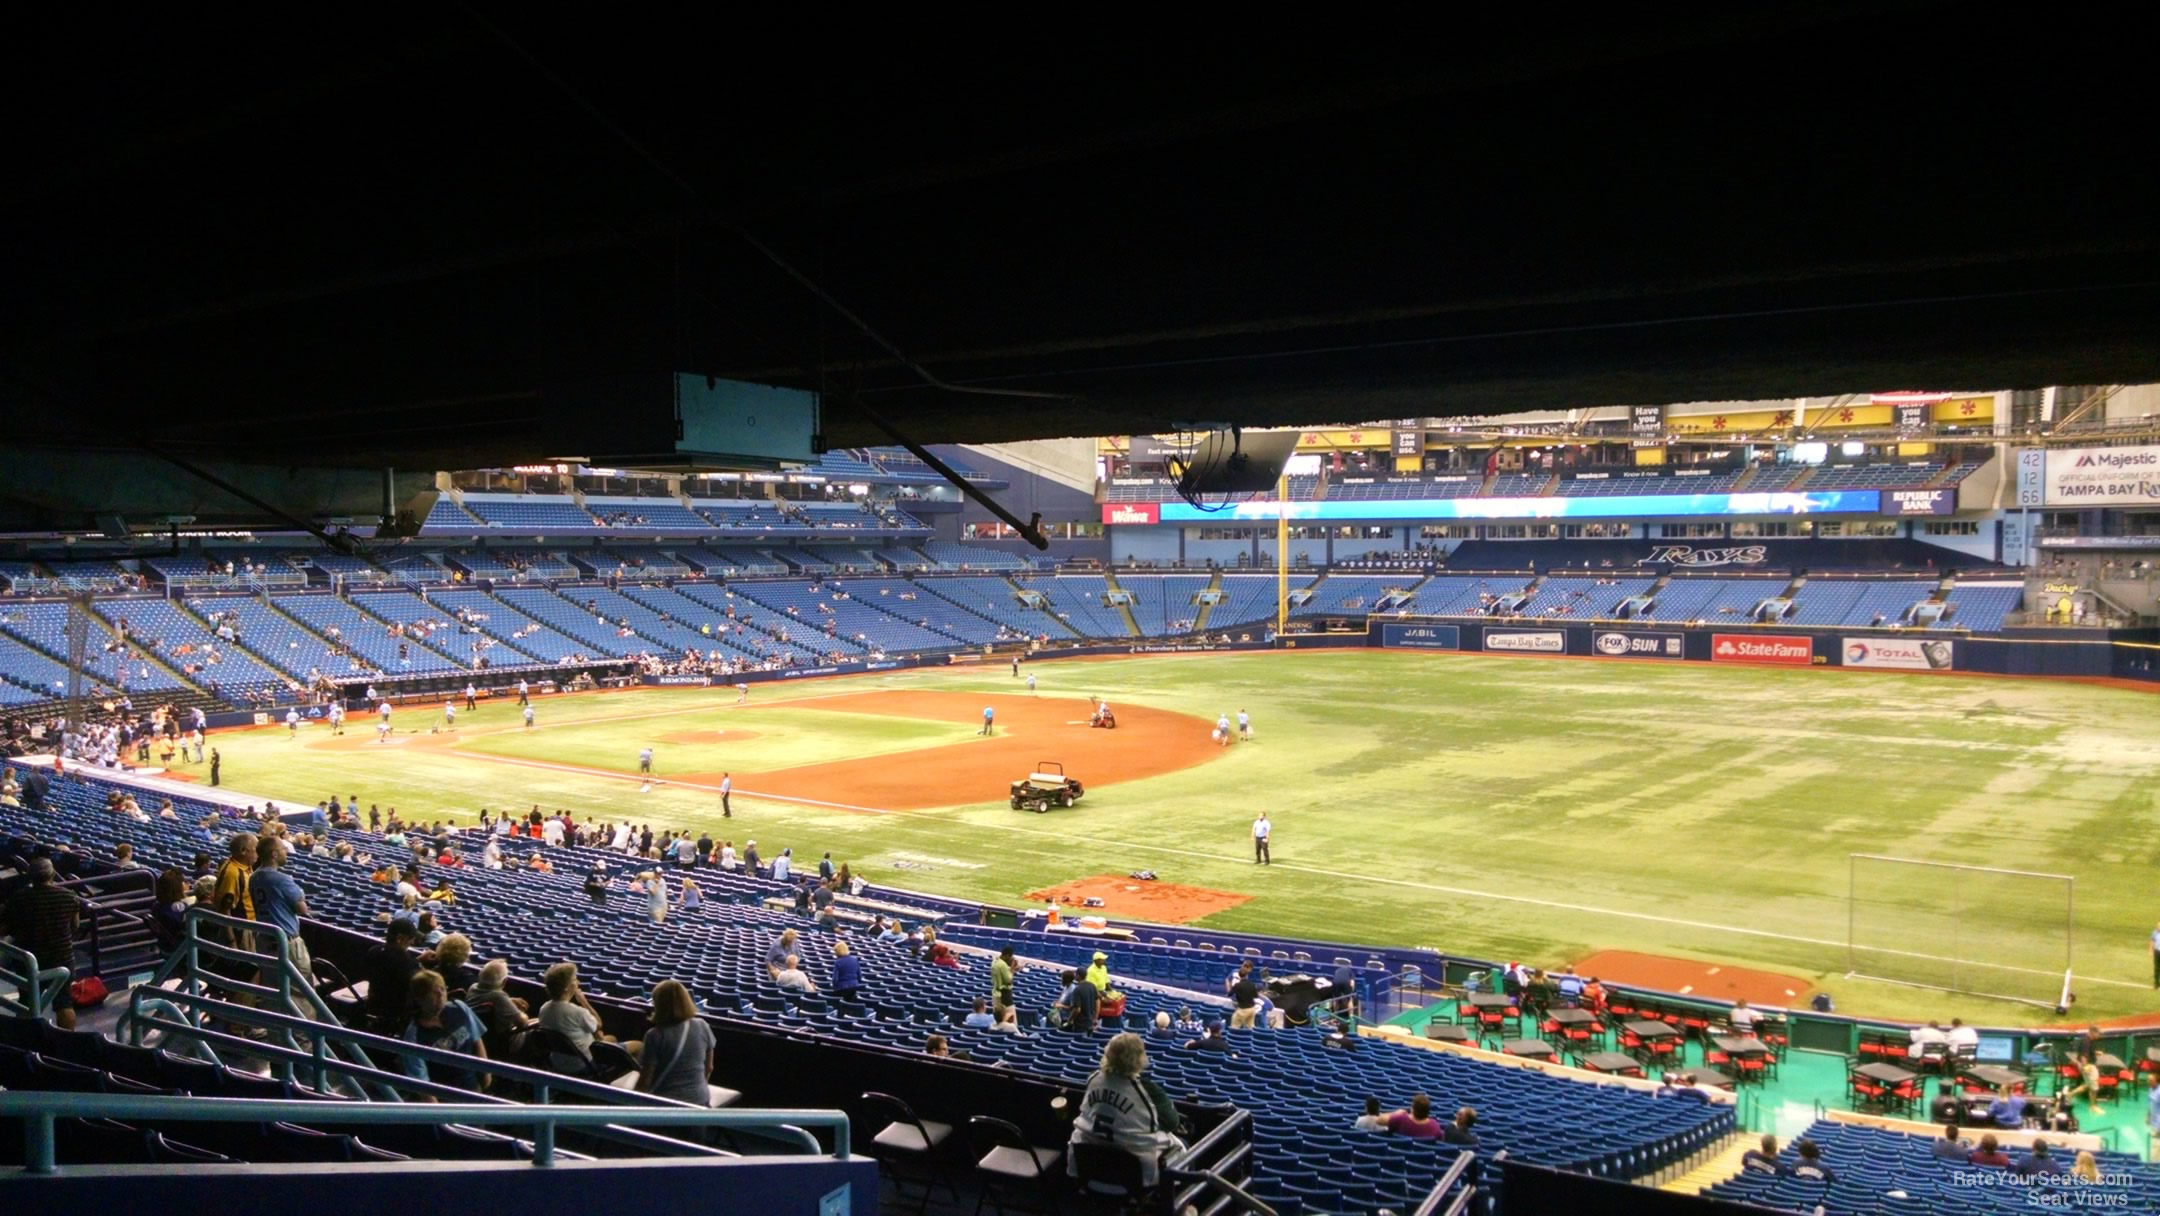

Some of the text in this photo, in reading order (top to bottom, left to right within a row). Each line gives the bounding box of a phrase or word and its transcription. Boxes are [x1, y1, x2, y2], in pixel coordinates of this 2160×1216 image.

[1635, 407, 1659, 416] Have
[1902, 409, 1920, 418] you
[1638, 417, 1656, 425] you
[1400, 434, 1415, 443] you
[2022, 454, 2040, 467] 42
[2098, 453, 2157, 469] Majestic
[2024, 472, 2038, 485] 12
[2058, 473, 2097, 482] OFFICIAL
[2098, 472, 2139, 481] UNIFORM
[2141, 471, 2153, 480] OF
[2058, 485, 2105, 496] TAMPA
[2109, 484, 2135, 495] BAY
[1893, 491, 1942, 501] REPUBLIC
[2021, 490, 2039, 503] 66
[1903, 501, 1932, 510] BANK
[1111, 510, 1149, 523] Wawa
[1638, 546, 1767, 567] RAYS
[1405, 629, 1437, 638] JABIL
[1490, 637, 1559, 648] Tampa Bay Times
[1604, 638, 1659, 651] FOX SUN
[1873, 648, 1921, 658] TOTAL
